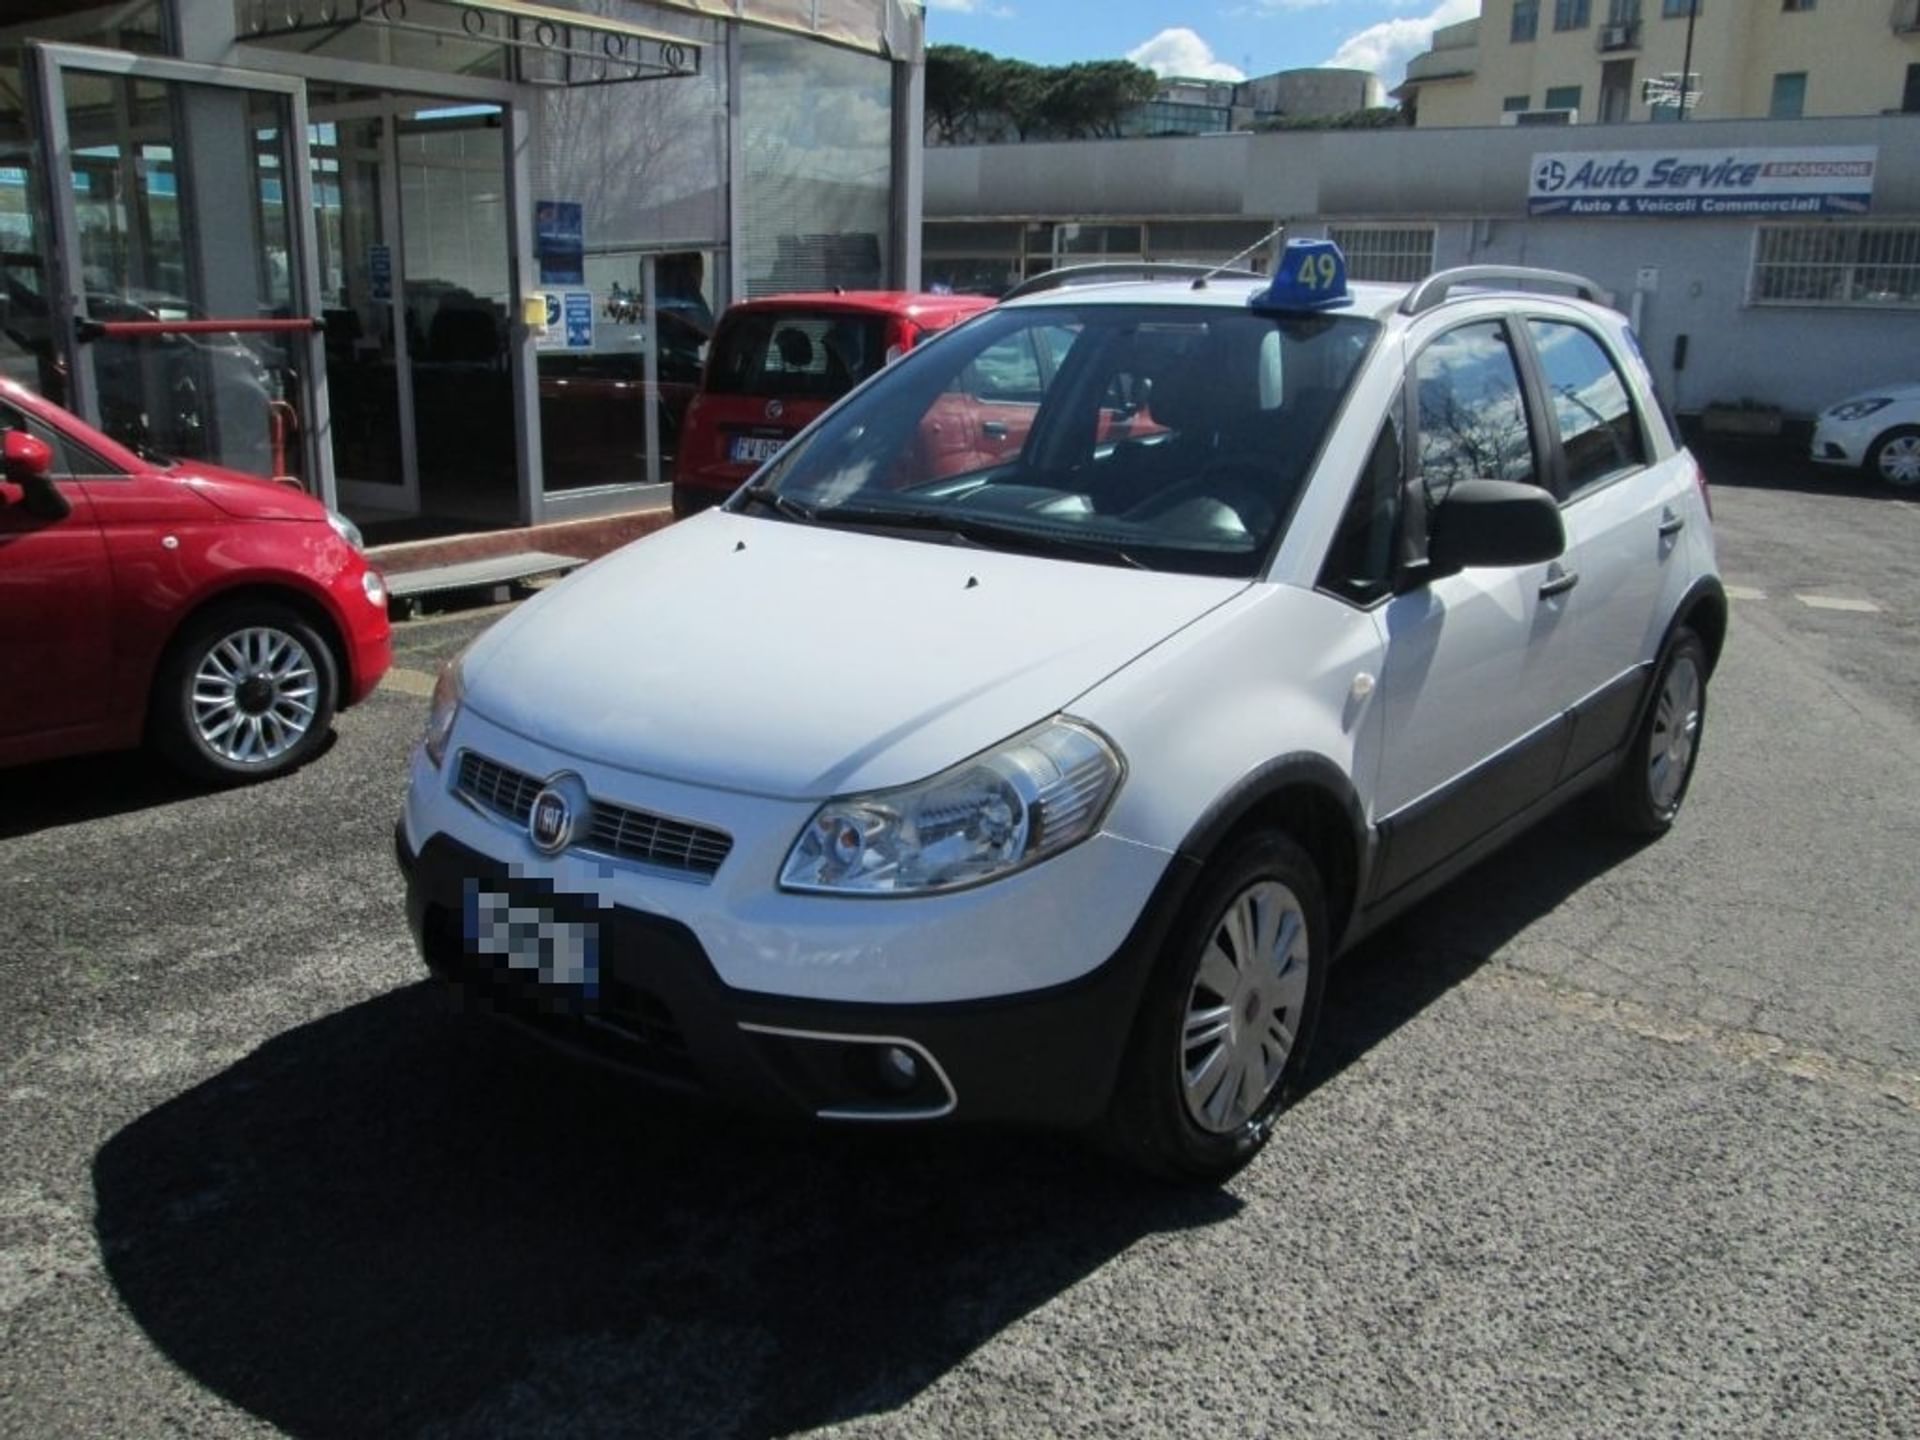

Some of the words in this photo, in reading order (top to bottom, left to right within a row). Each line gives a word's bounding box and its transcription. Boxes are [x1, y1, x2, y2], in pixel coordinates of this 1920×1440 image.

[1566, 158, 1640, 190] Auto
[1644, 157, 1762, 189] Service
[1571, 199, 1613, 212] Auto
[1617, 199, 1630, 212] &
[1636, 199, 1697, 212] Veicoli
[1701, 197, 1821, 212] Commerciali
[1297, 253, 1337, 290] 49
